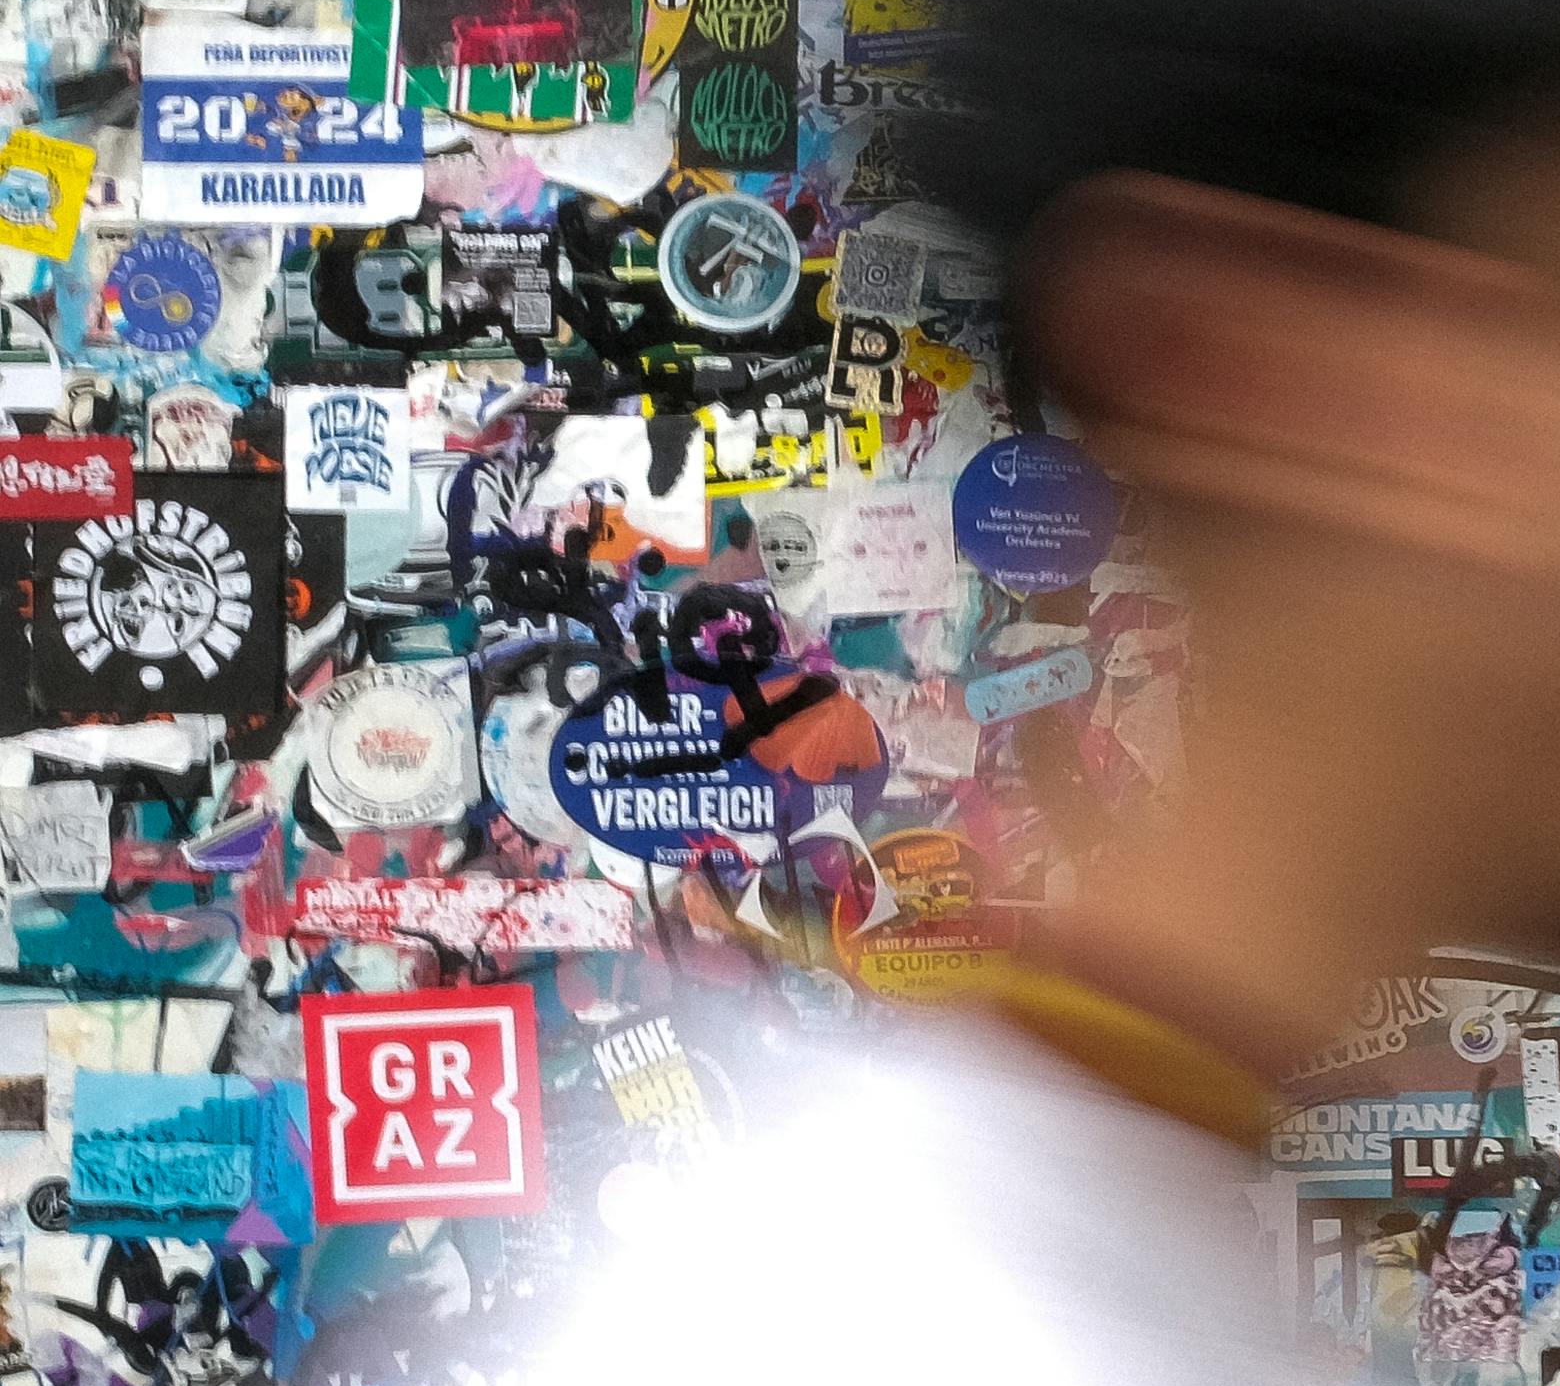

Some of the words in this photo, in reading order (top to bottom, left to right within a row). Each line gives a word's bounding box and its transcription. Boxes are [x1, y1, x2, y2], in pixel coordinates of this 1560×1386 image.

[156, 98, 245, 145] 20
[315, 98, 404, 142] 24
[200, 171, 366, 208] KARALLADA
[591, 785, 776, 832] VERGLEICH
[591, 1017, 682, 1078] KEINE
